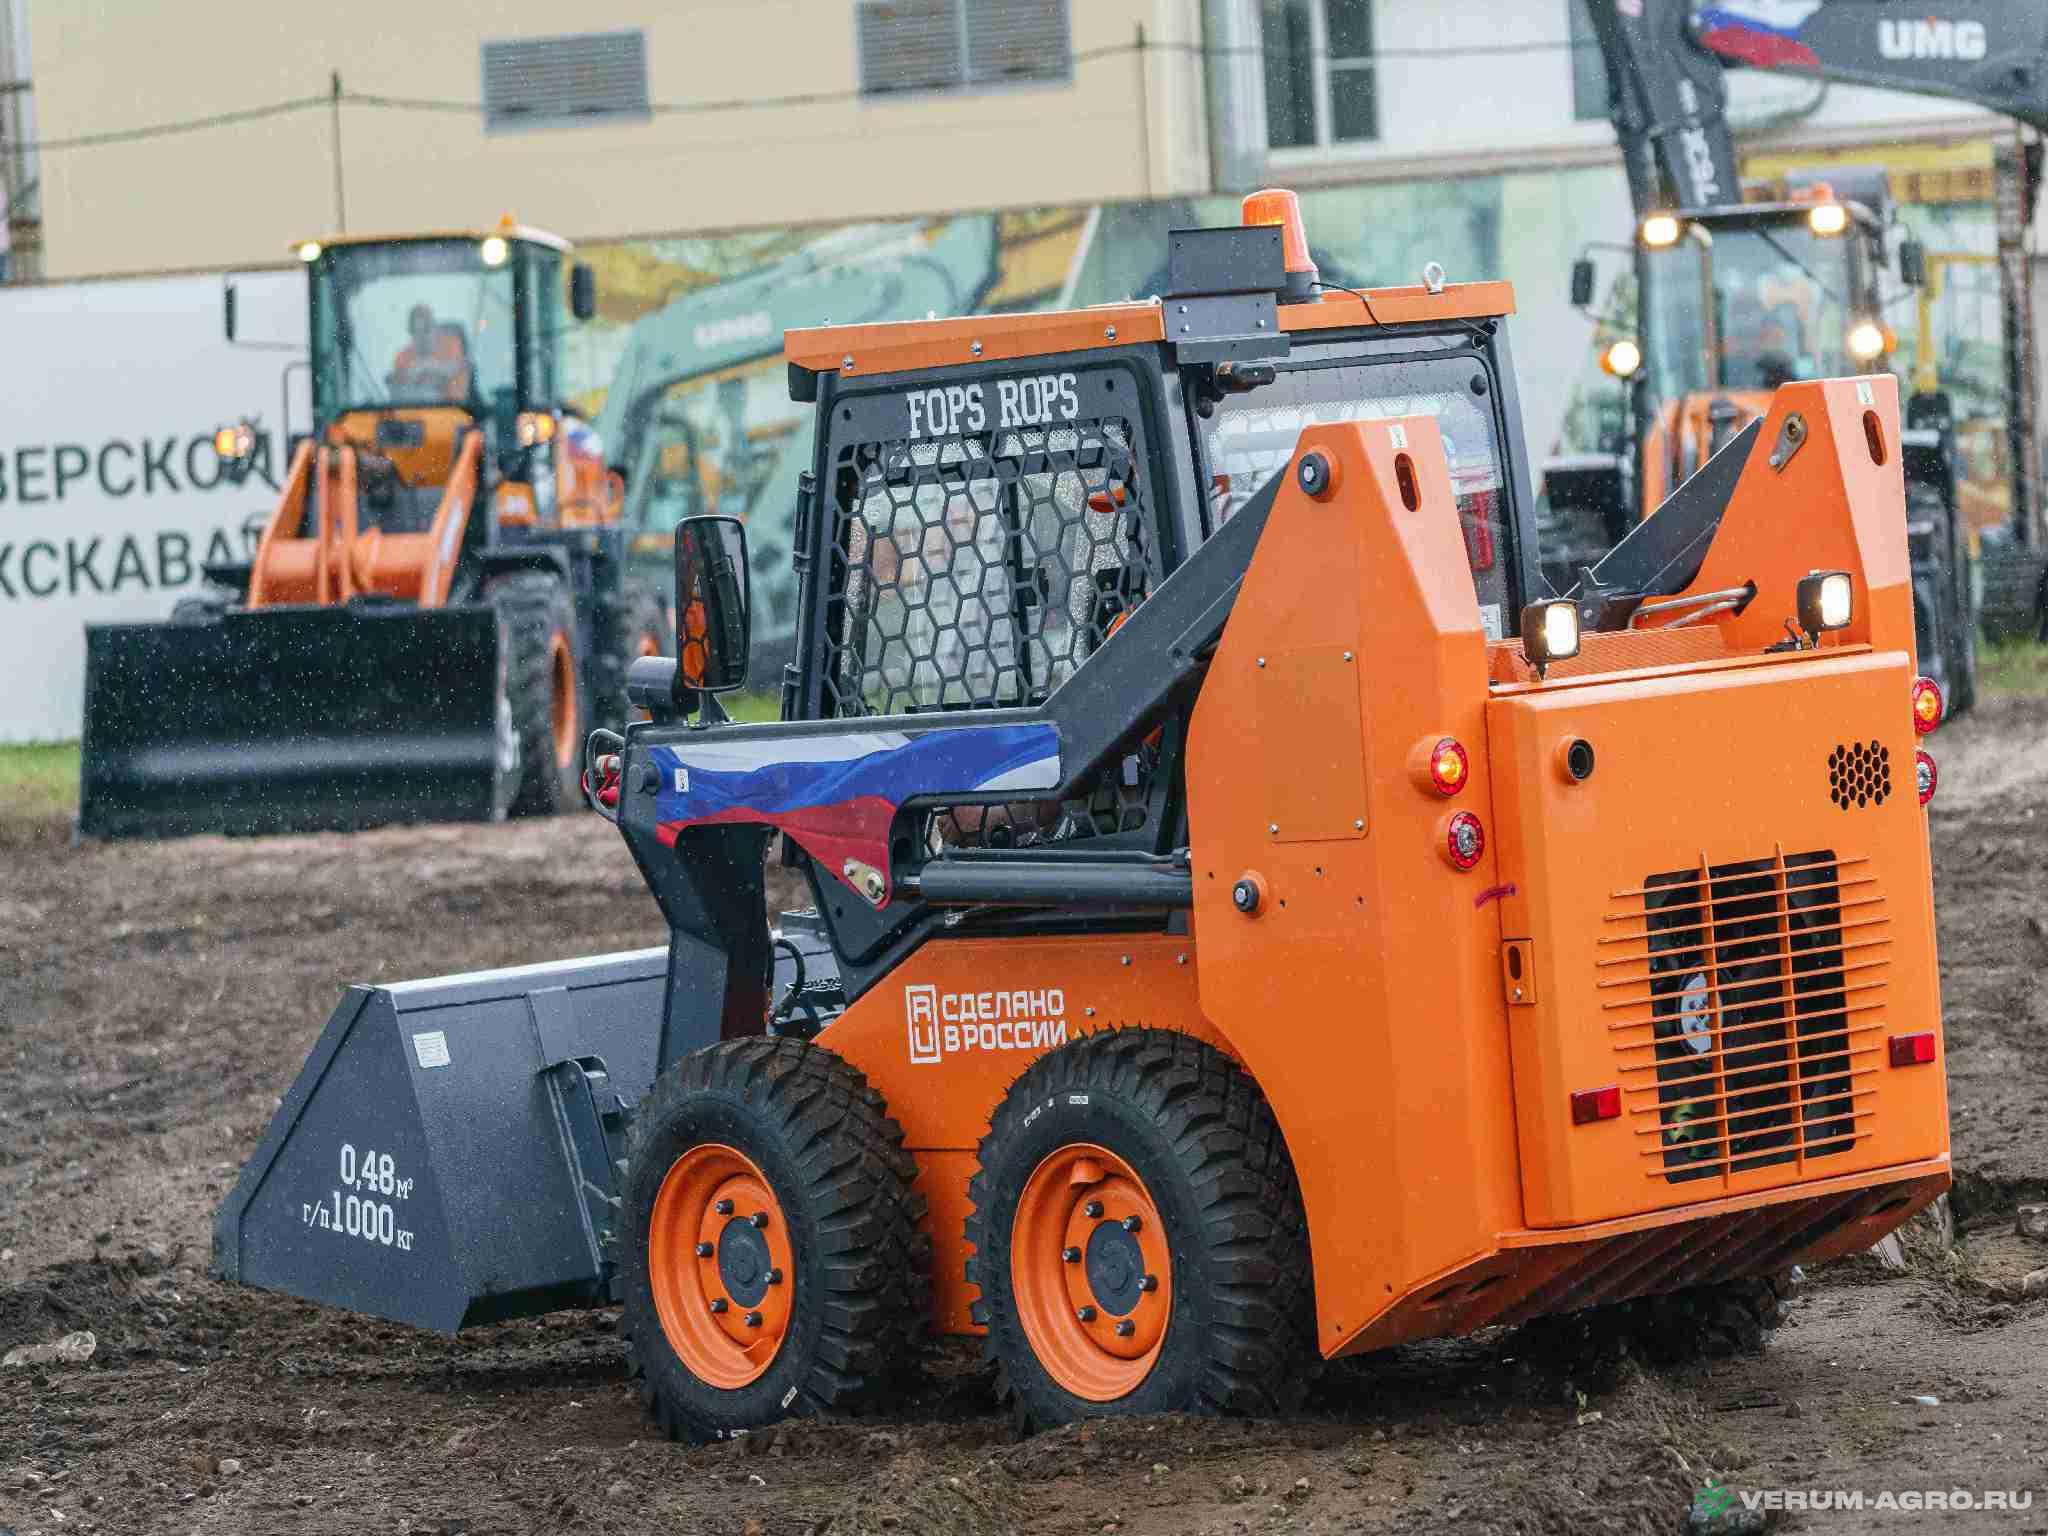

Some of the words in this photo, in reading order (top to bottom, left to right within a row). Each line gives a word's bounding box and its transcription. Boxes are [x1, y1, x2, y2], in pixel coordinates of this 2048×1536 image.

[1878, 18, 1987, 60] UMG
[906, 383, 986, 439] FOPS
[996, 372, 1080, 428] ROPS
[942, 989, 1065, 1022] СДЕЛАНО
[340, 1143, 395, 1196] 0,48
[332, 1190, 395, 1246] 1000
